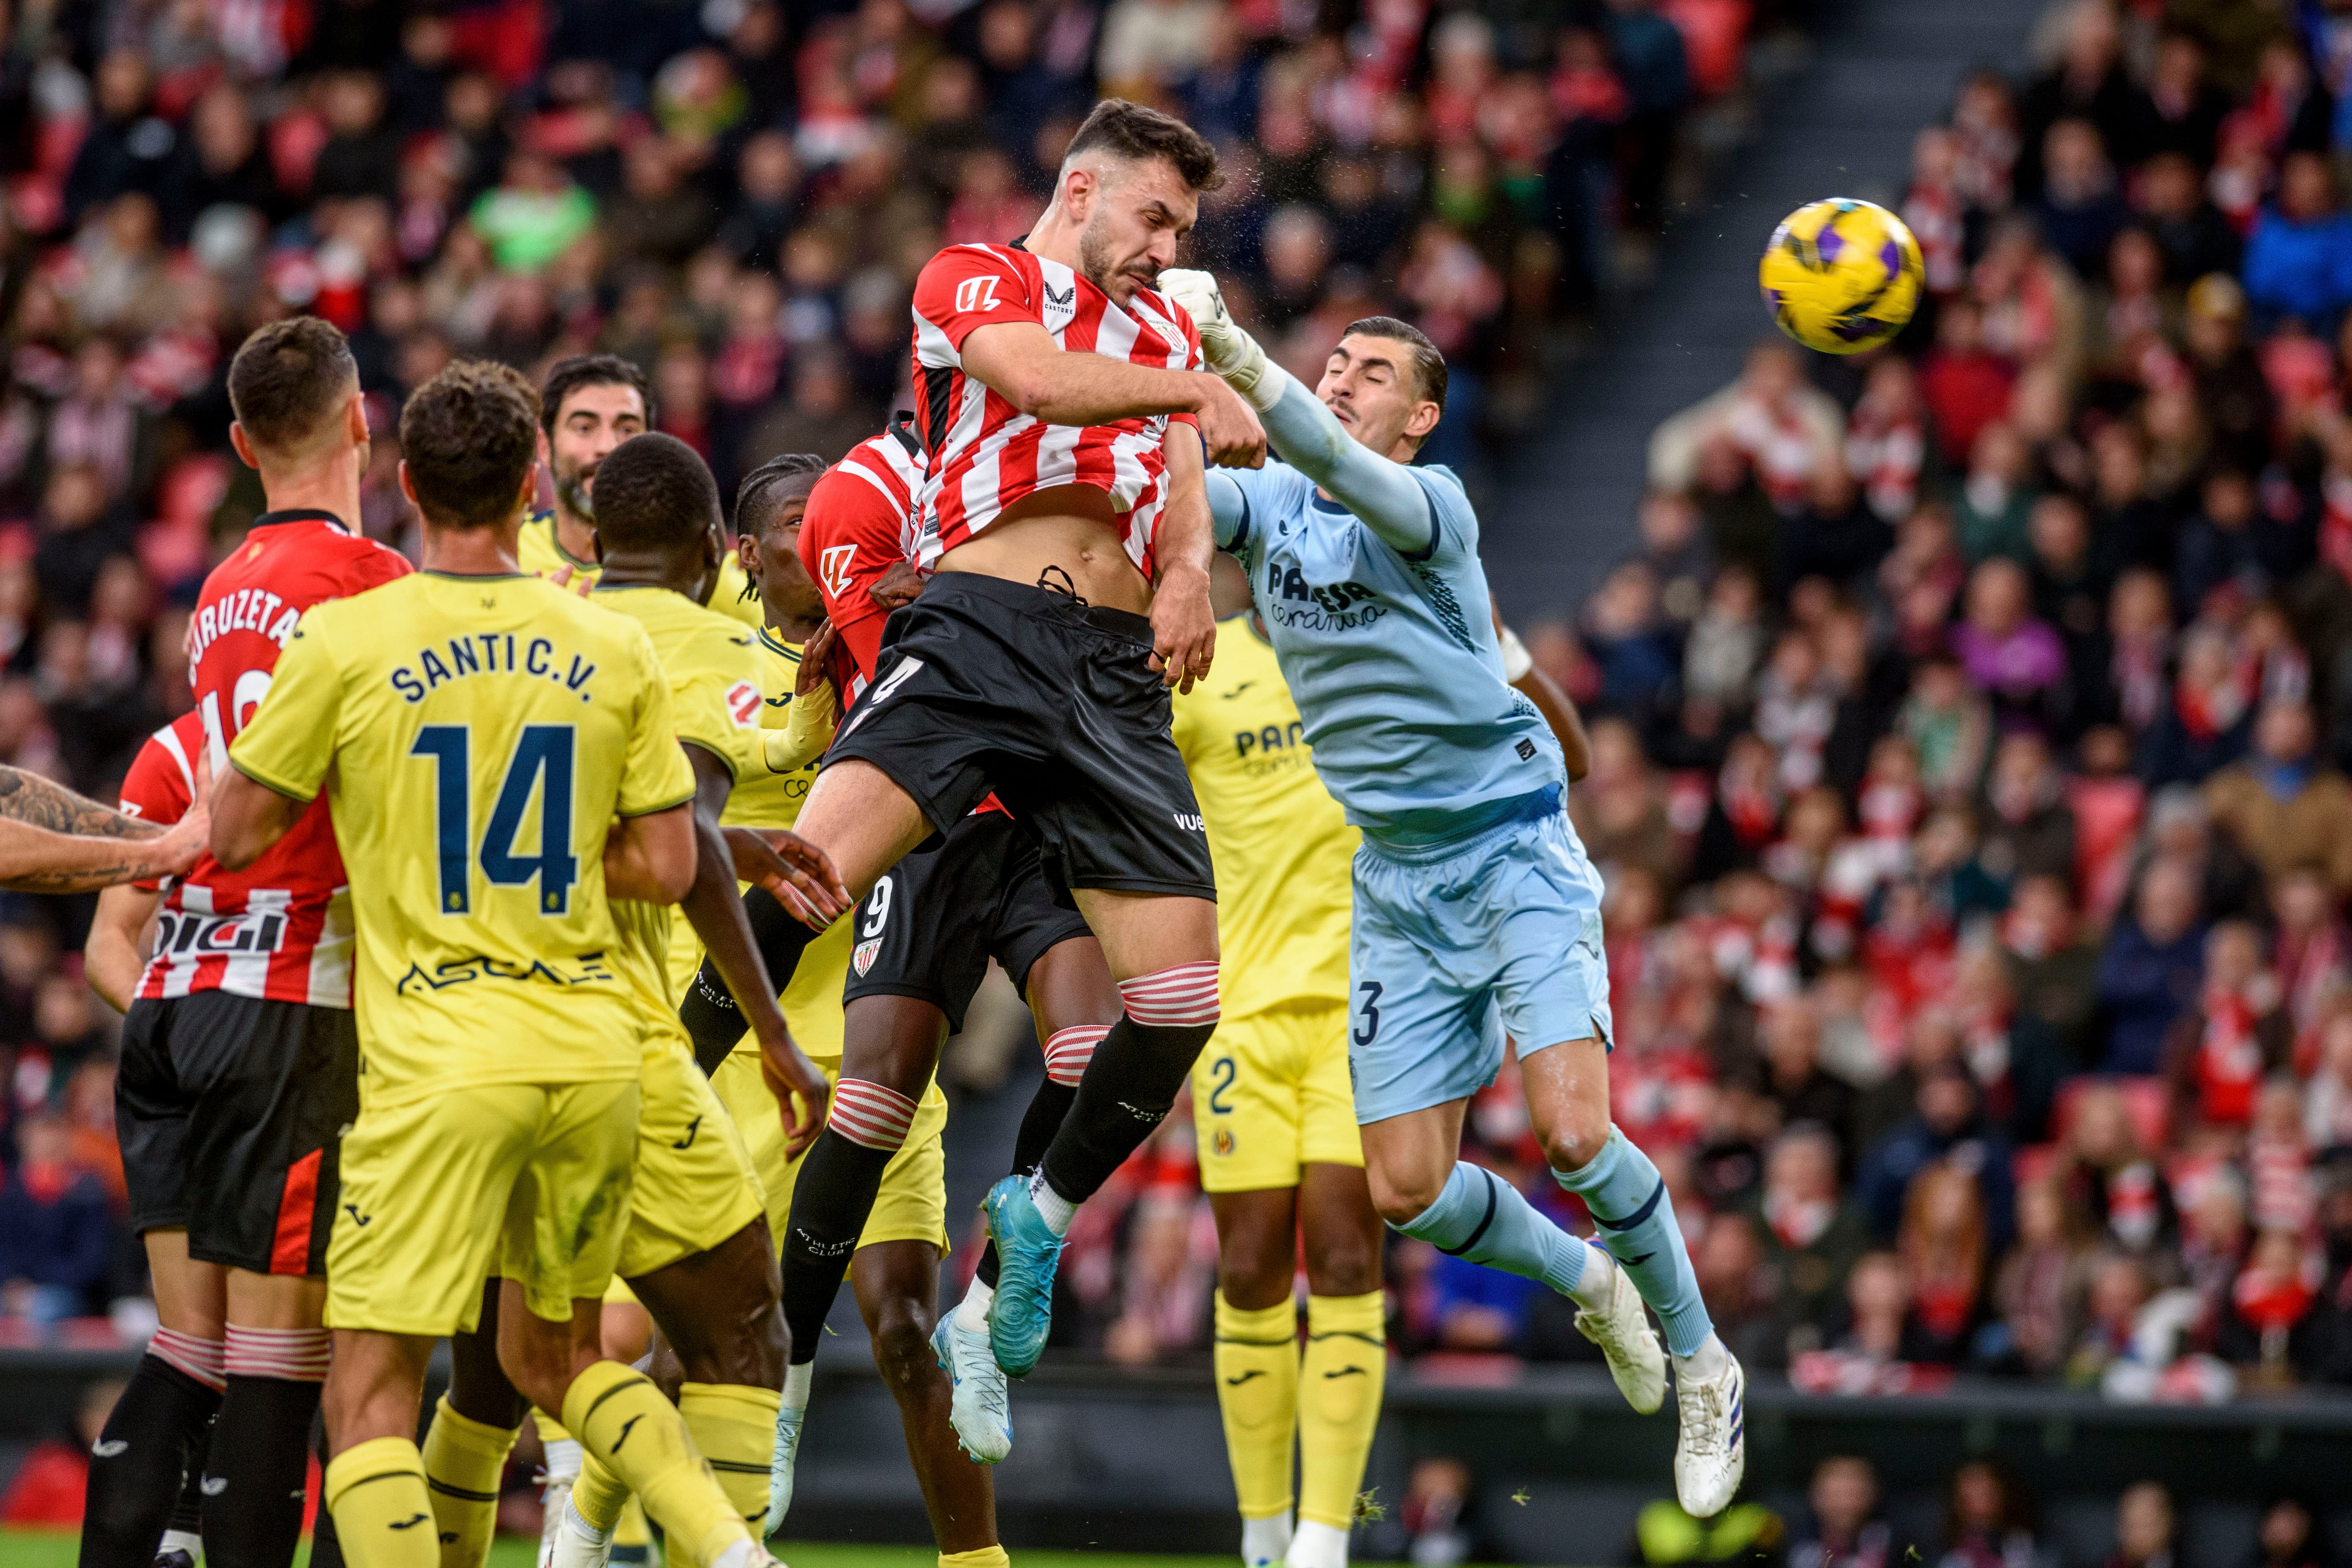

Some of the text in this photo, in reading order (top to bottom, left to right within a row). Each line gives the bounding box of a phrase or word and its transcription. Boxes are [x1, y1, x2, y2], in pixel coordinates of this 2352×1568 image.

[1045, 303, 1073, 315] CASTORE
[1268, 562, 1377, 613] PAESA
[391, 634, 595, 703] SANTI C.V.
[410, 725, 578, 915] 14
[863, 875, 893, 938] 9
[1353, 981, 1383, 1046] 3
[1210, 1058, 1235, 1114] 2
[797, 1228, 855, 1250] ATHLETIC
[809, 1246, 844, 1256] CLUB
